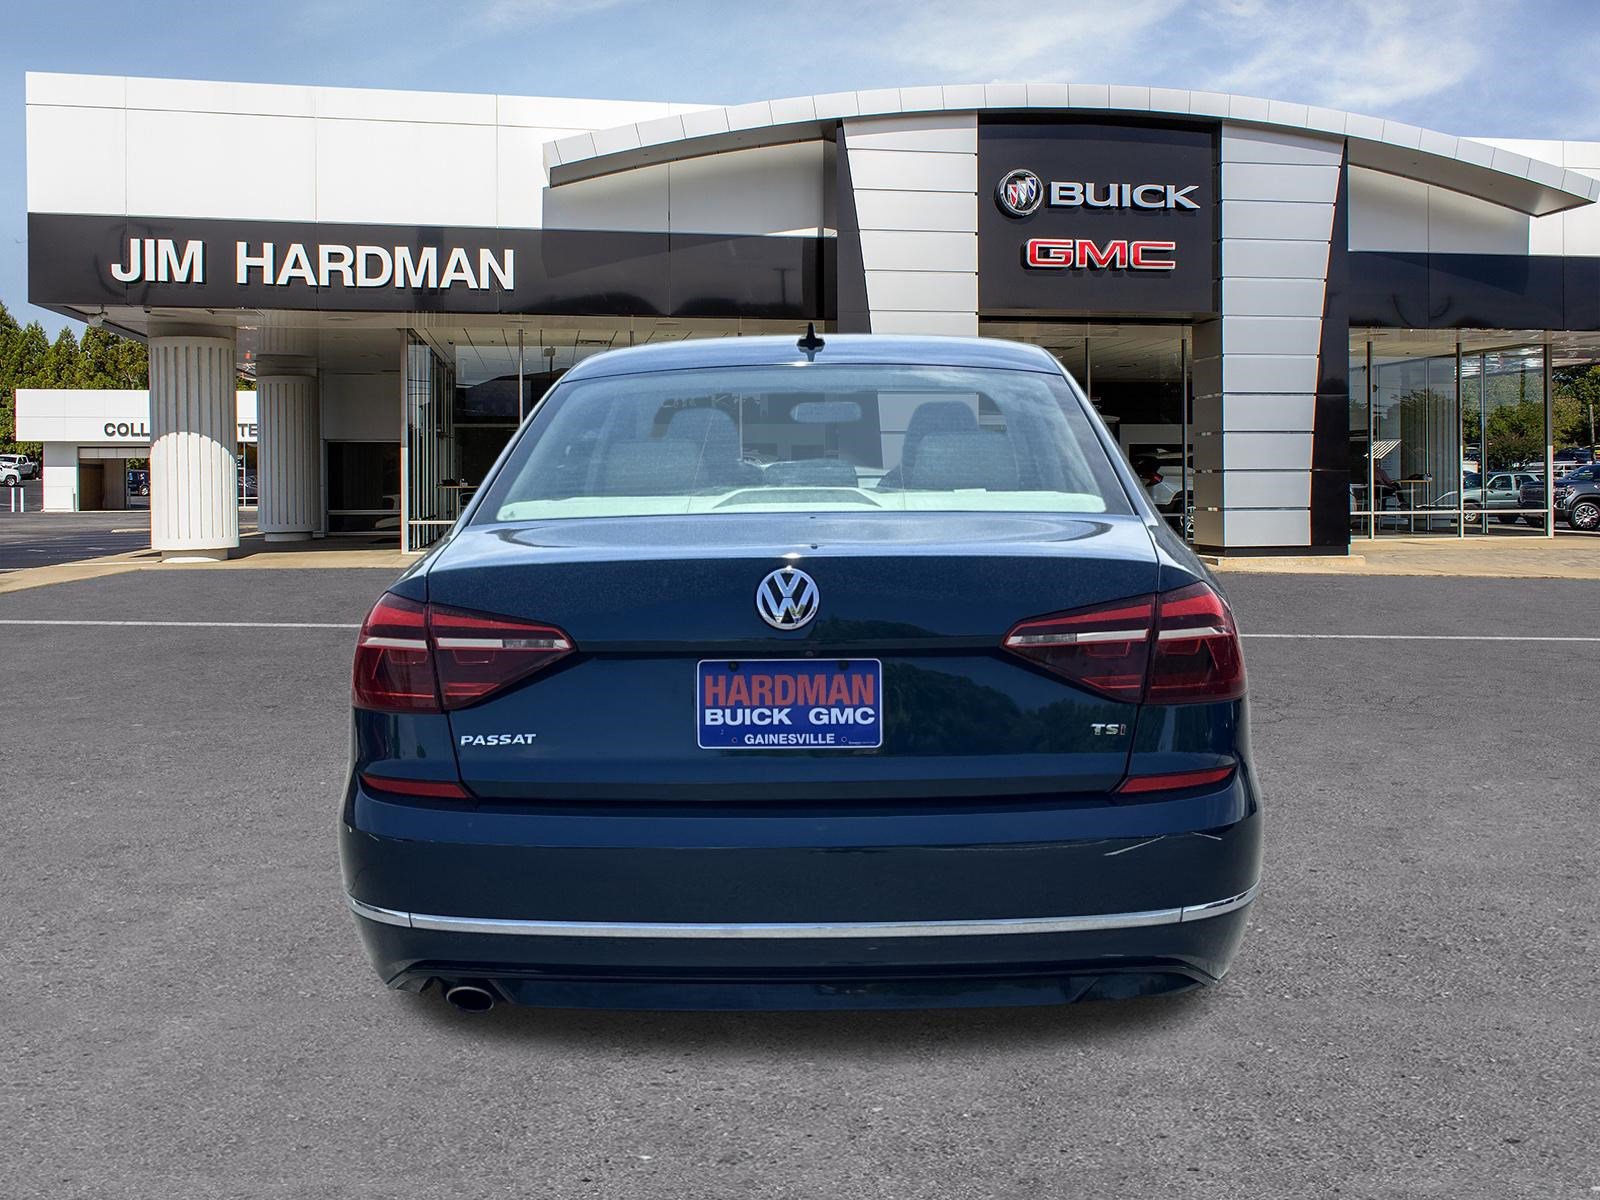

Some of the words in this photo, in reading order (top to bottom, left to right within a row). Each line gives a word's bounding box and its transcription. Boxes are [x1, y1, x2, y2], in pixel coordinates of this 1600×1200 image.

[1049, 181, 1200, 209] BUICK
[110, 238, 206, 283] JIM
[236, 241, 515, 291] HARDMAN
[1025, 238, 1176, 270] GMC
[704, 674, 874, 706] HARDMAN
[704, 708, 792, 726] BUICK
[808, 707, 875, 725] GMC
[460, 733, 537, 746] PASSAT
[744, 733, 835, 745] GAINESVILLE
